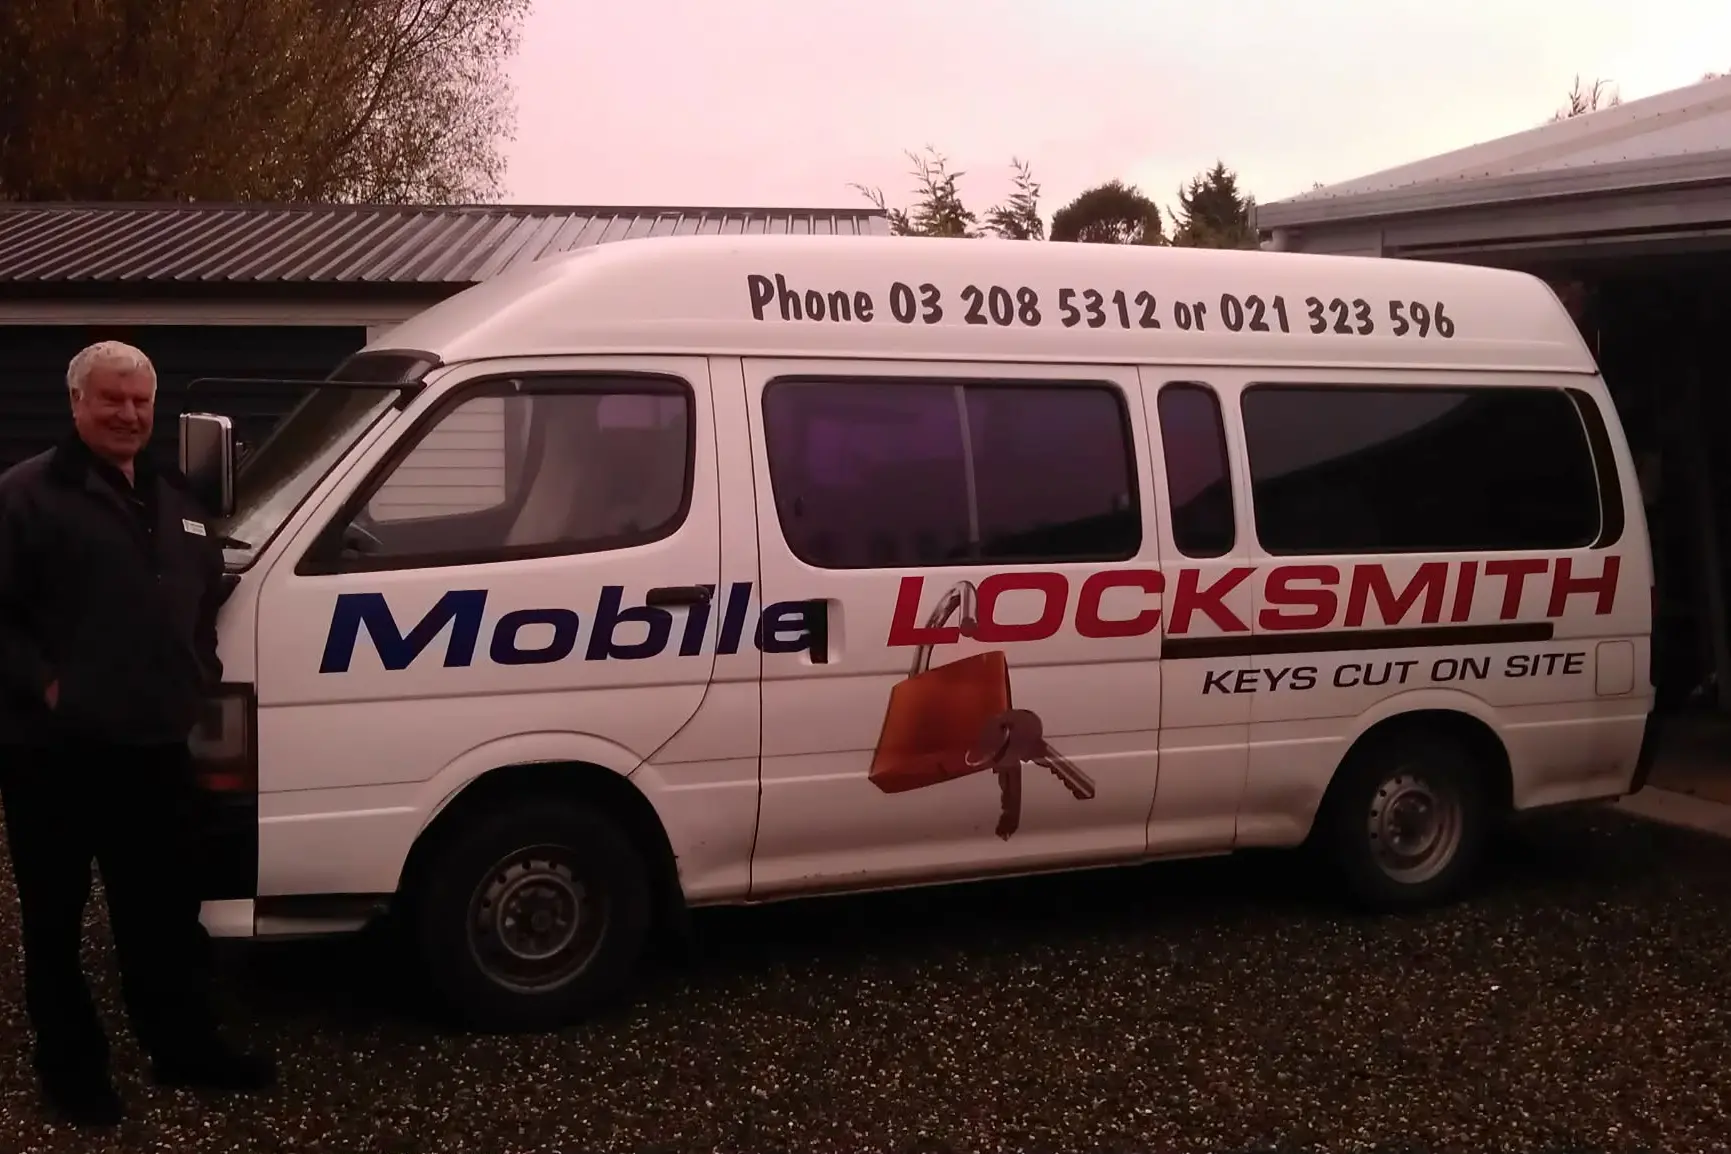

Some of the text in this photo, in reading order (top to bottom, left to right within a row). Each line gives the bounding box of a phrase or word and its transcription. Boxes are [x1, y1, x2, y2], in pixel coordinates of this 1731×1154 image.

[748, 274, 1454, 338] Phone 03 208 5312 or 021 323 596
[319, 555, 1622, 674] Mobile LOCKSMITH
[1203, 652, 1585, 694] KEYS CUT ON SITE
